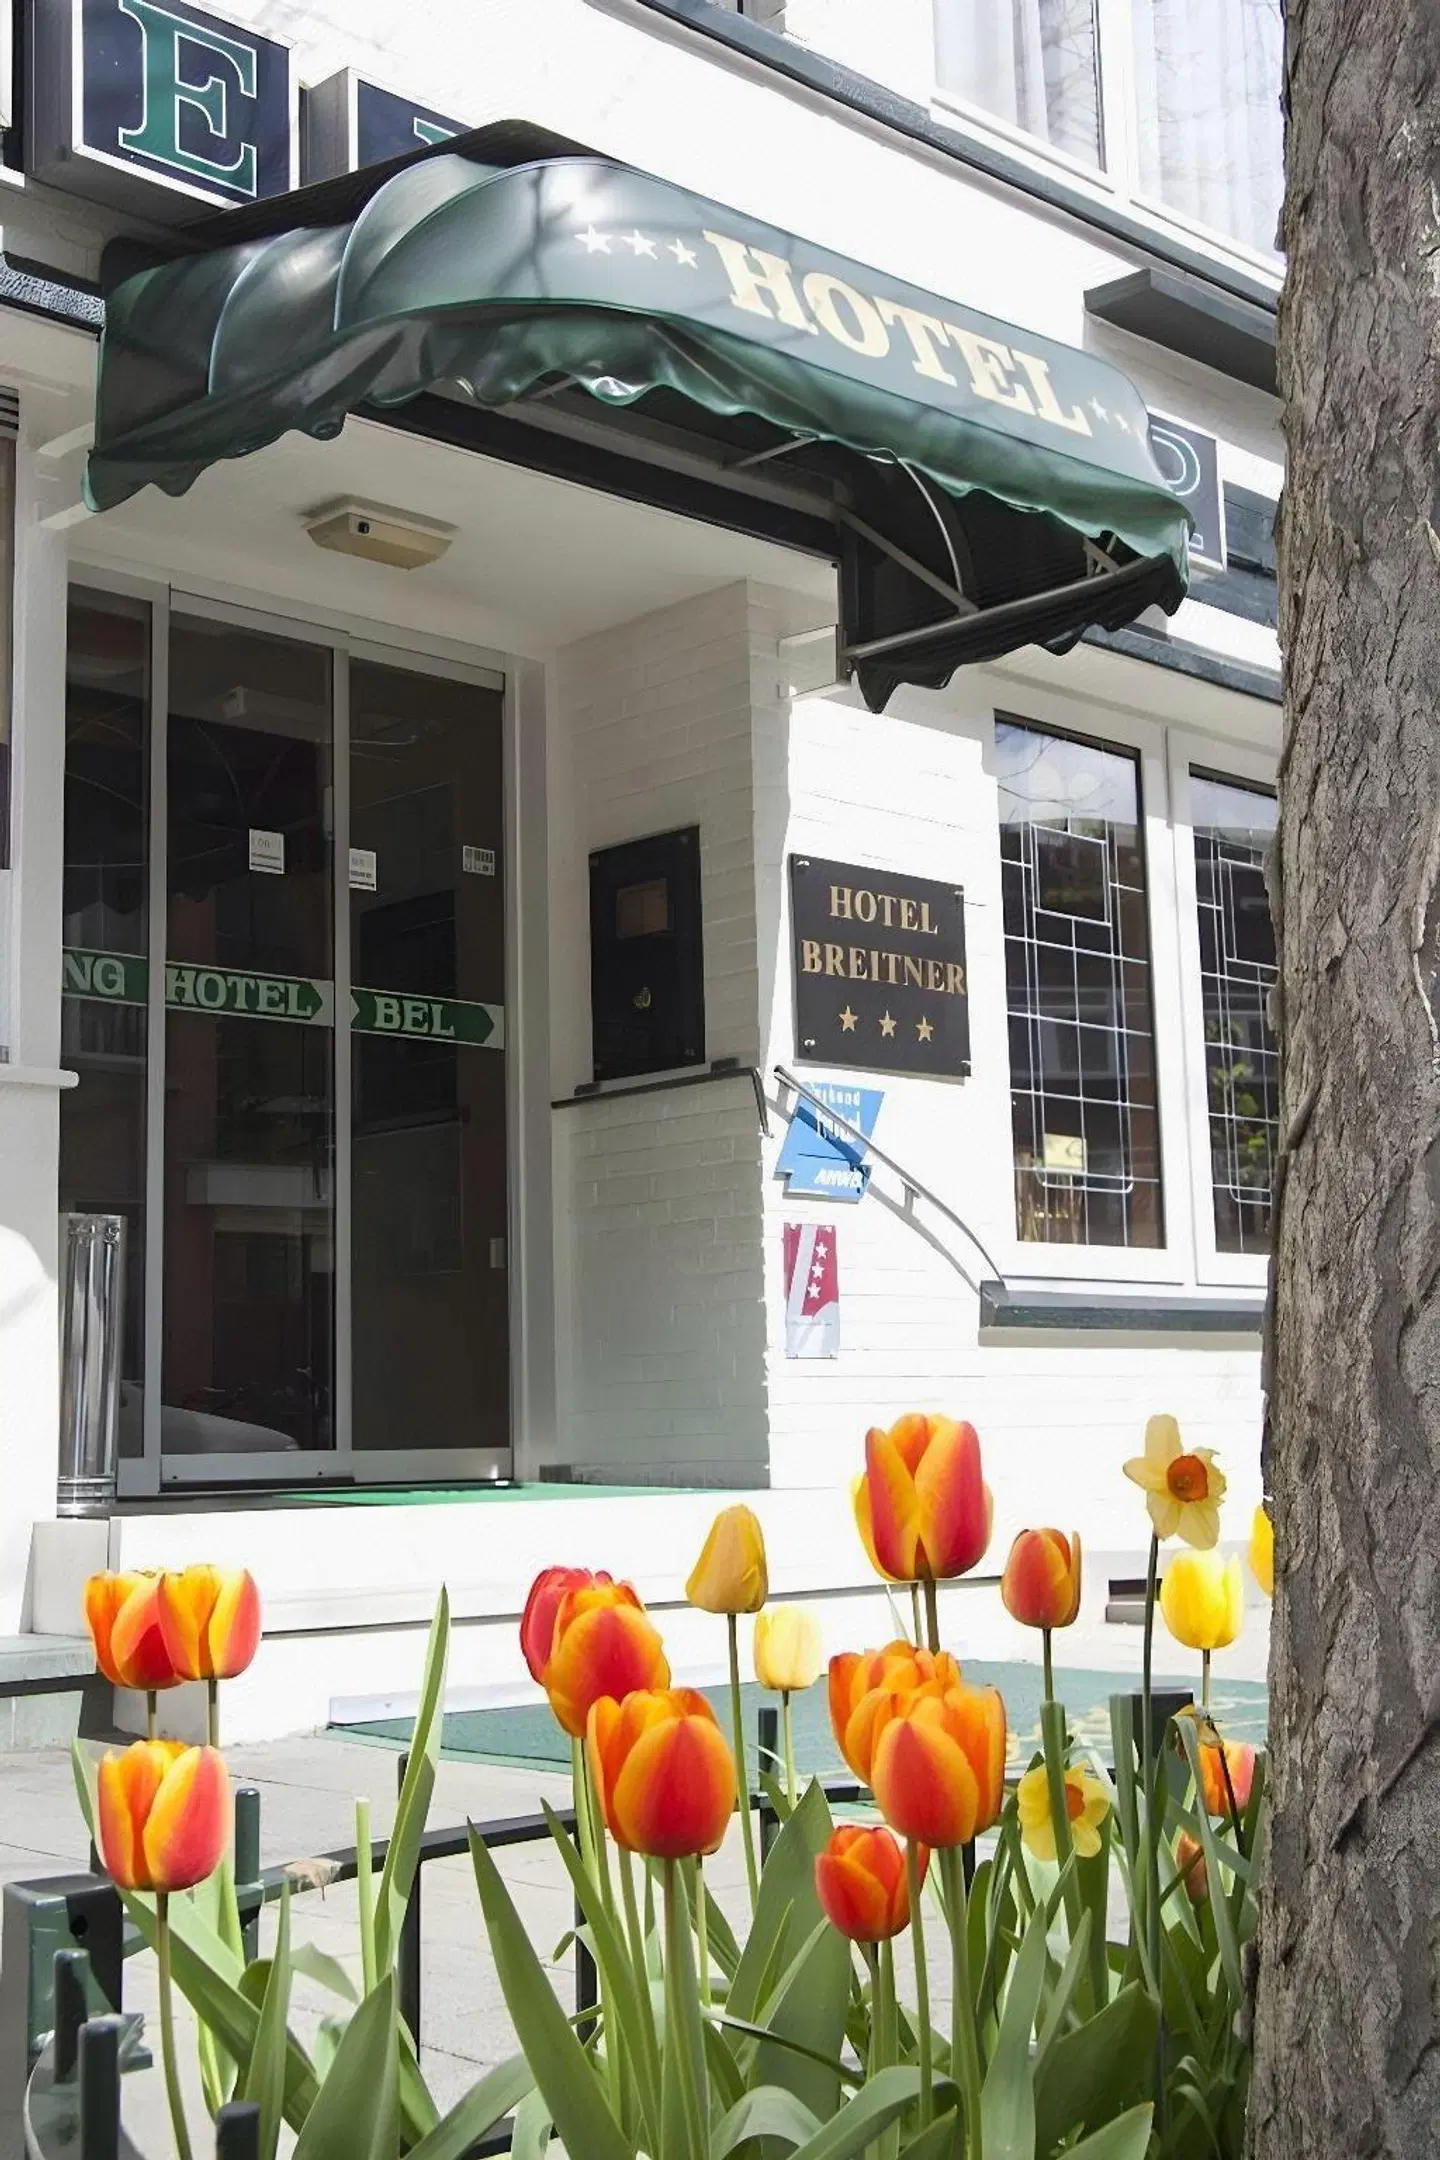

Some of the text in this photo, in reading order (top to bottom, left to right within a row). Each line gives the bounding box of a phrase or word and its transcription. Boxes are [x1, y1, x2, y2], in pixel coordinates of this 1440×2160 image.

[117, 0, 257, 198] E
[702, 229, 1093, 438] HOTEL
[829, 885, 938, 935] HOTEL
[62, 953, 456, 1037] NG HOTEL BEL
[801, 939, 967, 997] BREITNER
